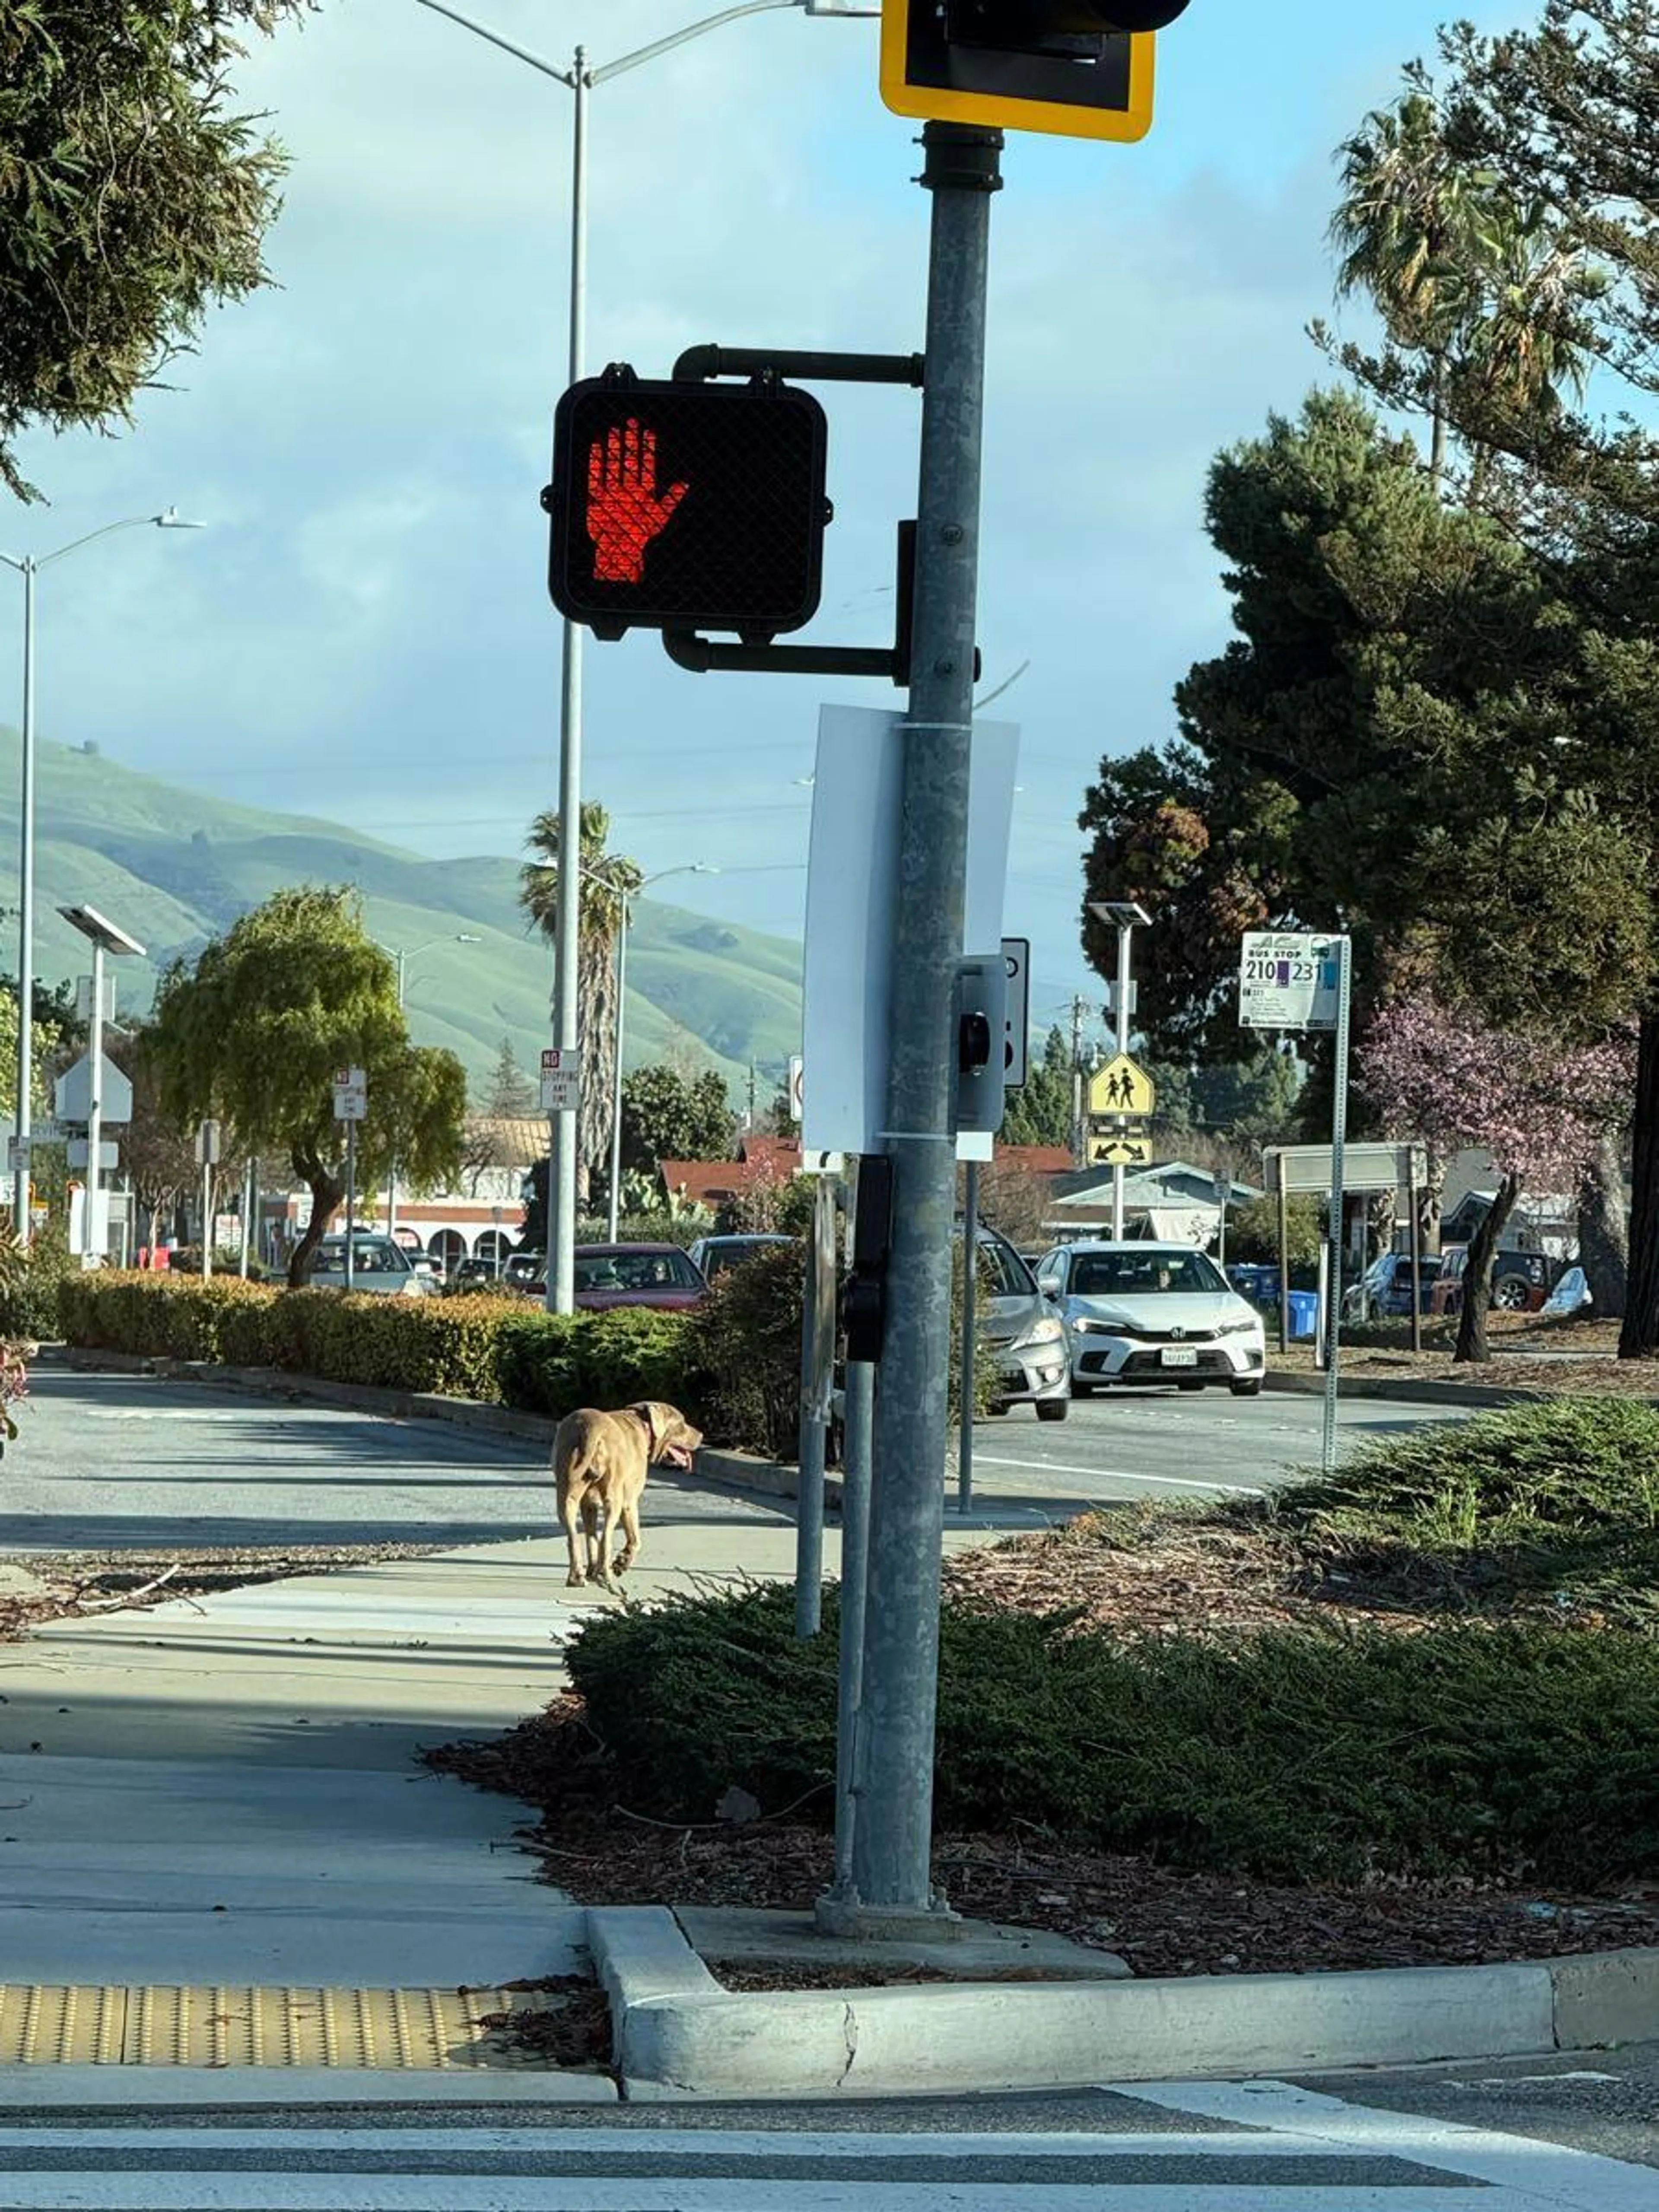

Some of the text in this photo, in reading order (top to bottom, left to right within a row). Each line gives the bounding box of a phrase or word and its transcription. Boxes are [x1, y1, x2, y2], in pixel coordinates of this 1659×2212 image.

[1246, 960, 1321, 981] 210 231
[543, 1052, 557, 1066] NO
